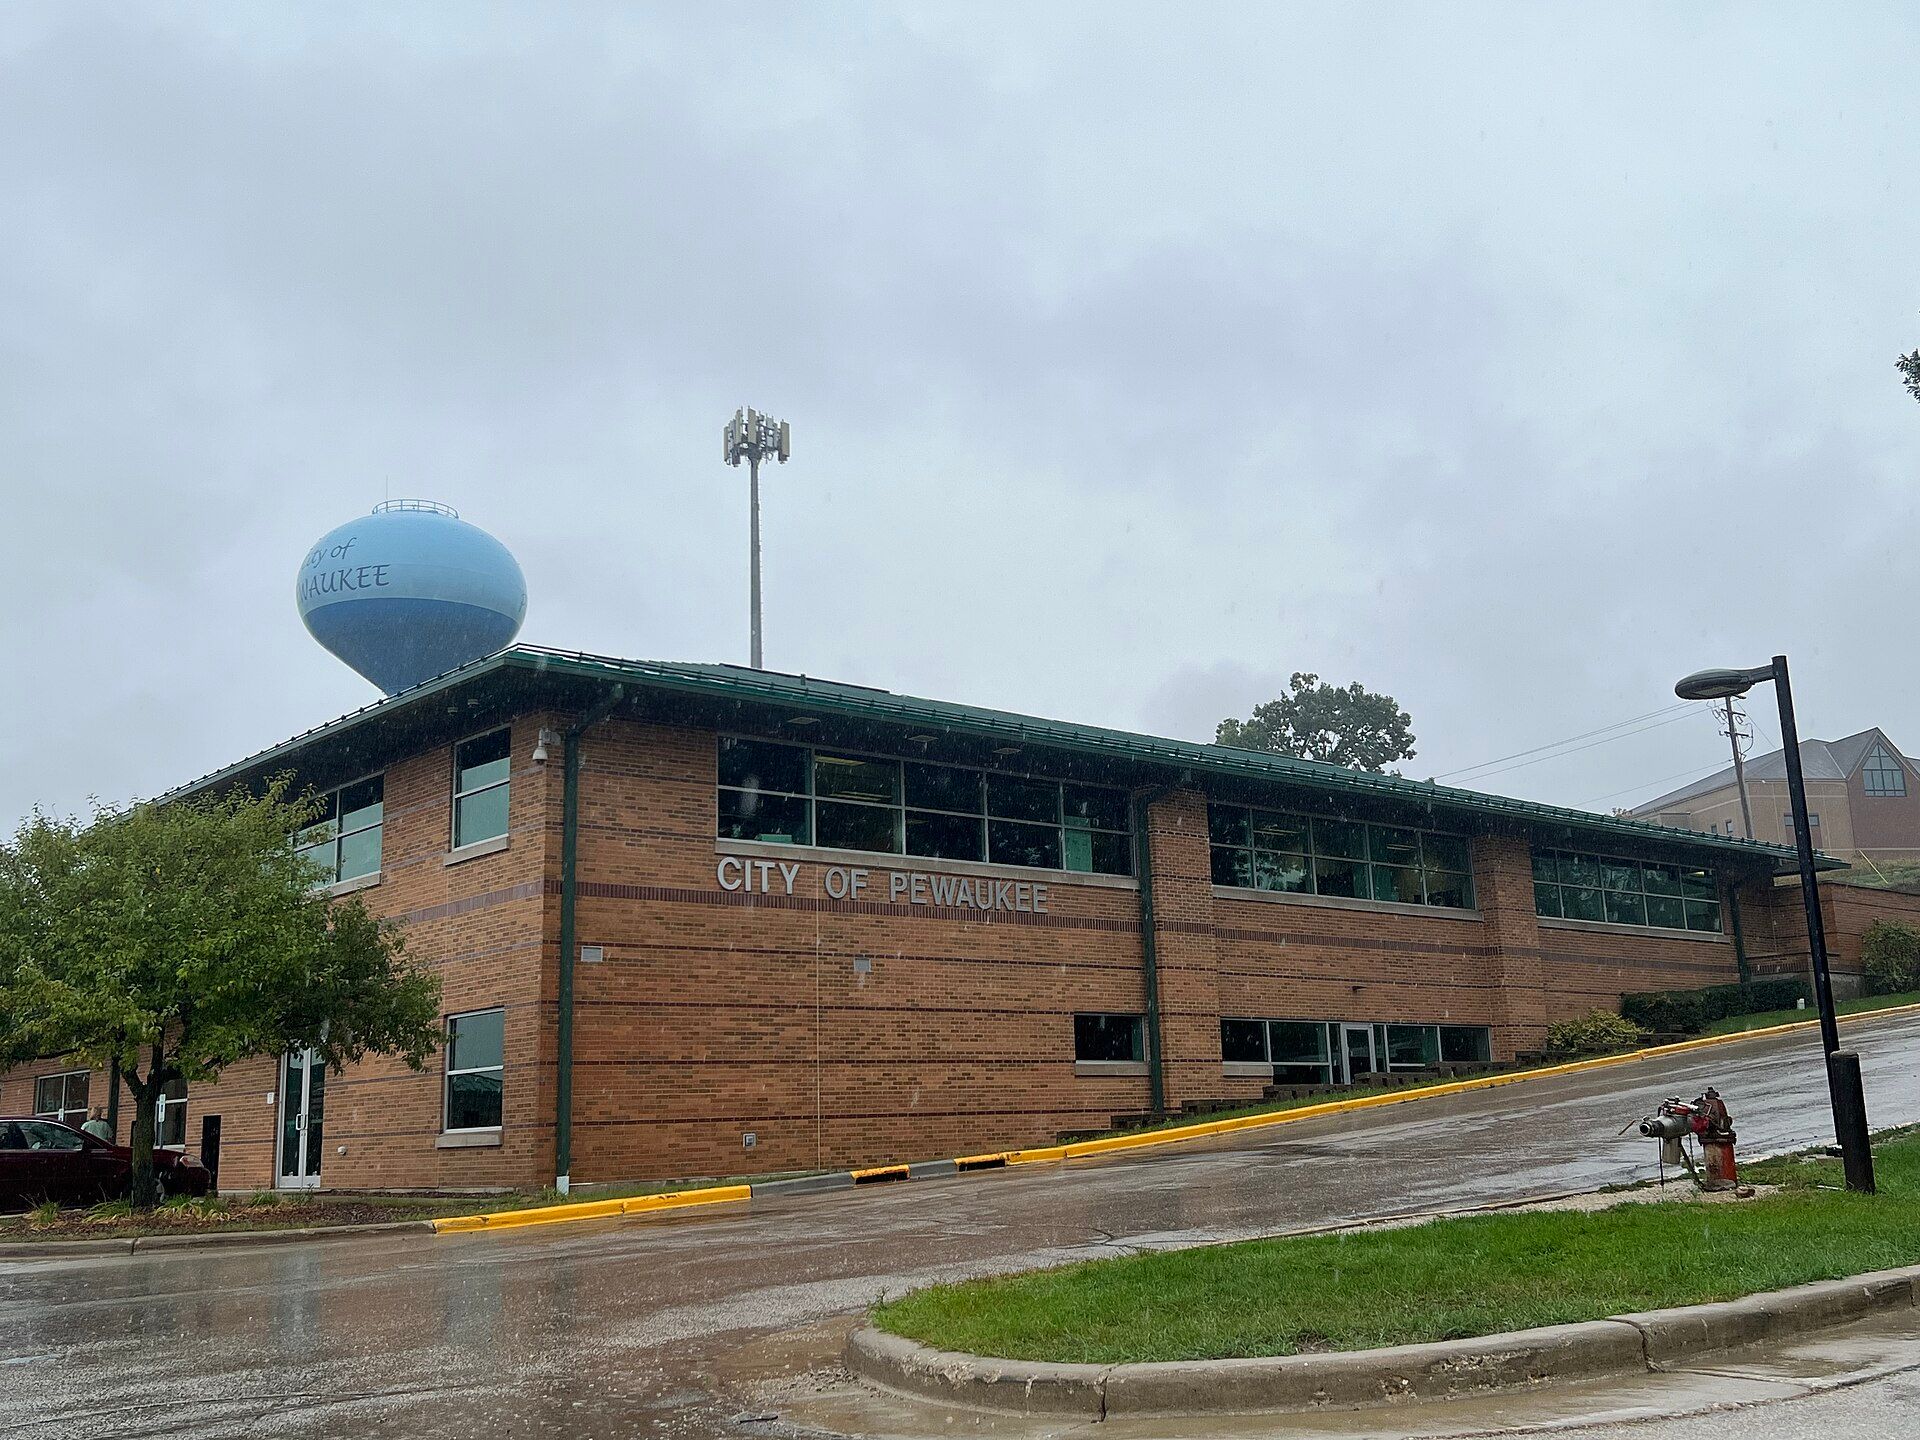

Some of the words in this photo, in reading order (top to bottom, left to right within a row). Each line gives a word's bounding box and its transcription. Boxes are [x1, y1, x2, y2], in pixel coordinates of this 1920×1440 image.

[330, 537, 357, 559] of
[717, 856, 800, 895] CITY
[824, 867, 868, 899] OF
[890, 871, 1049, 913] PEWAUKEE
